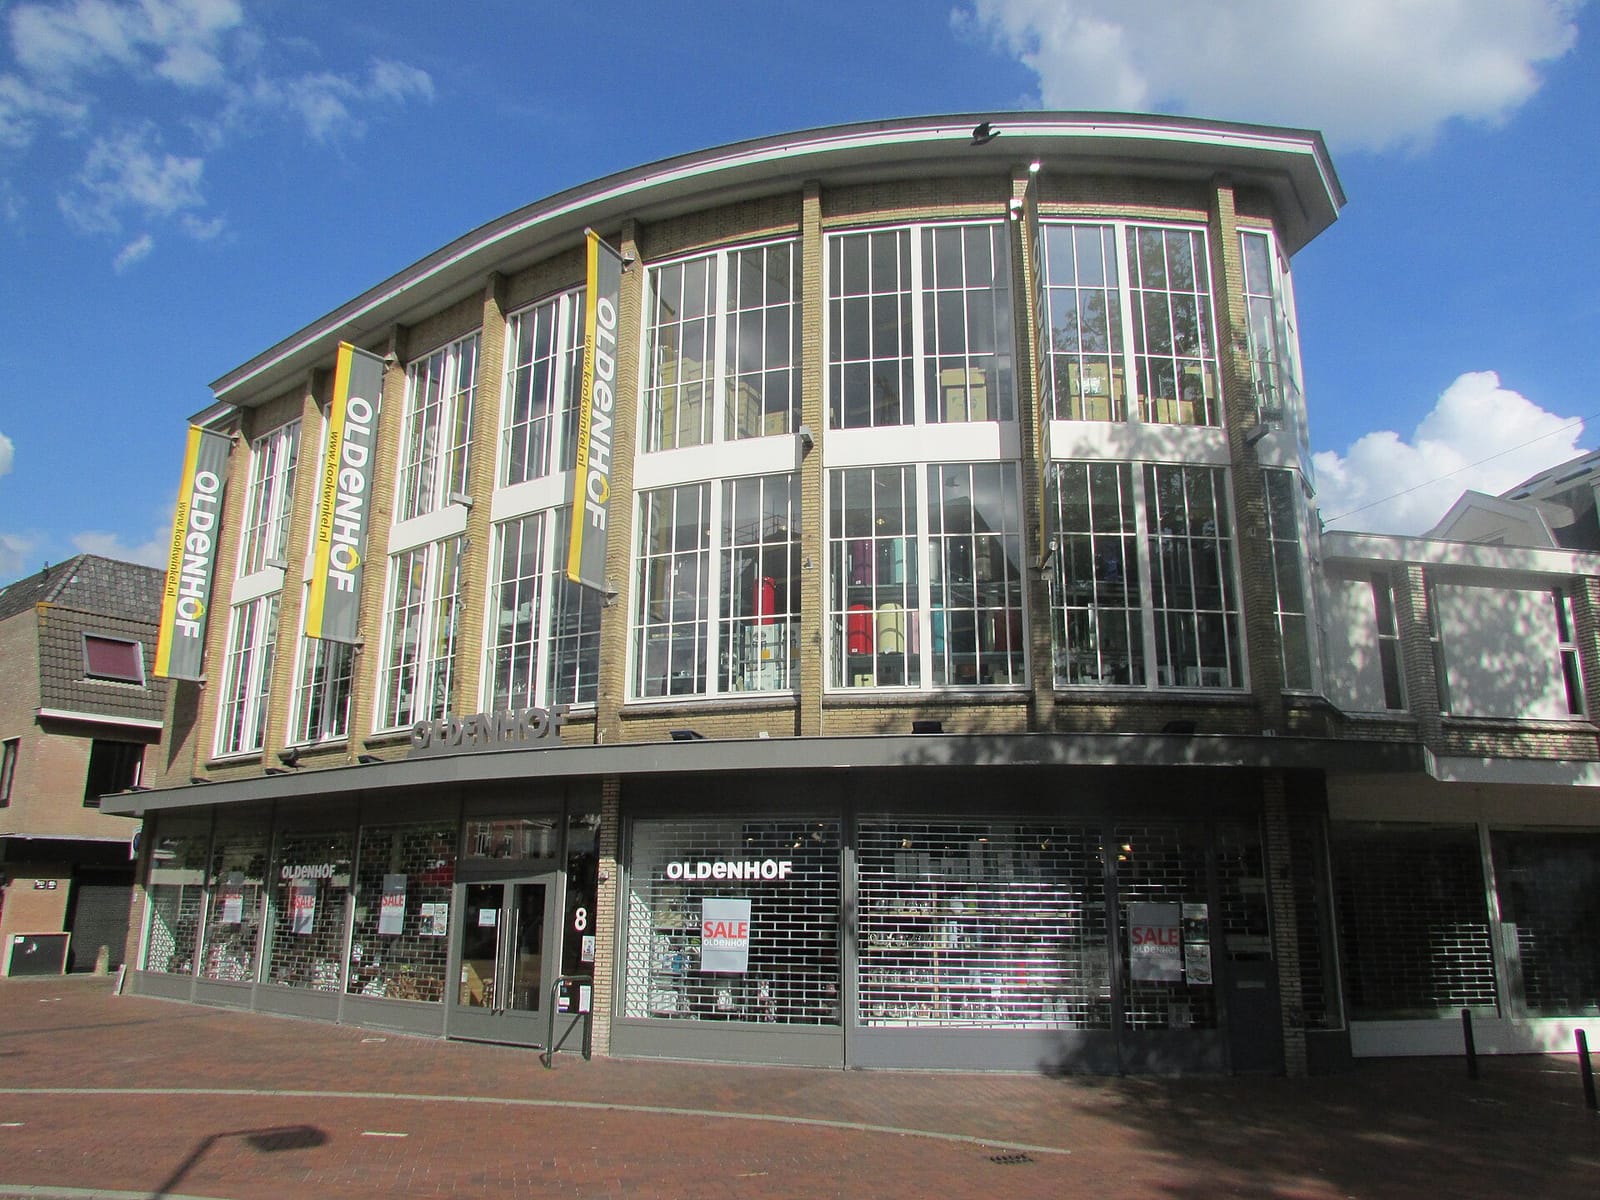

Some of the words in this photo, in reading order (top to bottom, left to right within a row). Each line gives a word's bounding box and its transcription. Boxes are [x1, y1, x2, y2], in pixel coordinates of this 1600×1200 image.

[577, 334, 592, 468] www.kookwinkel.nl
[319, 431, 338, 543] www.kookwinkel.nl
[167, 502, 187, 597] www.kookwinkel.nl
[410, 704, 570, 748] OLDENHOF
[295, 895, 314, 909] SALE
[382, 892, 404, 907] SALE
[574, 907, 587, 931] 8
[703, 921, 748, 939] SALE
[1132, 926, 1178, 946] SALE
